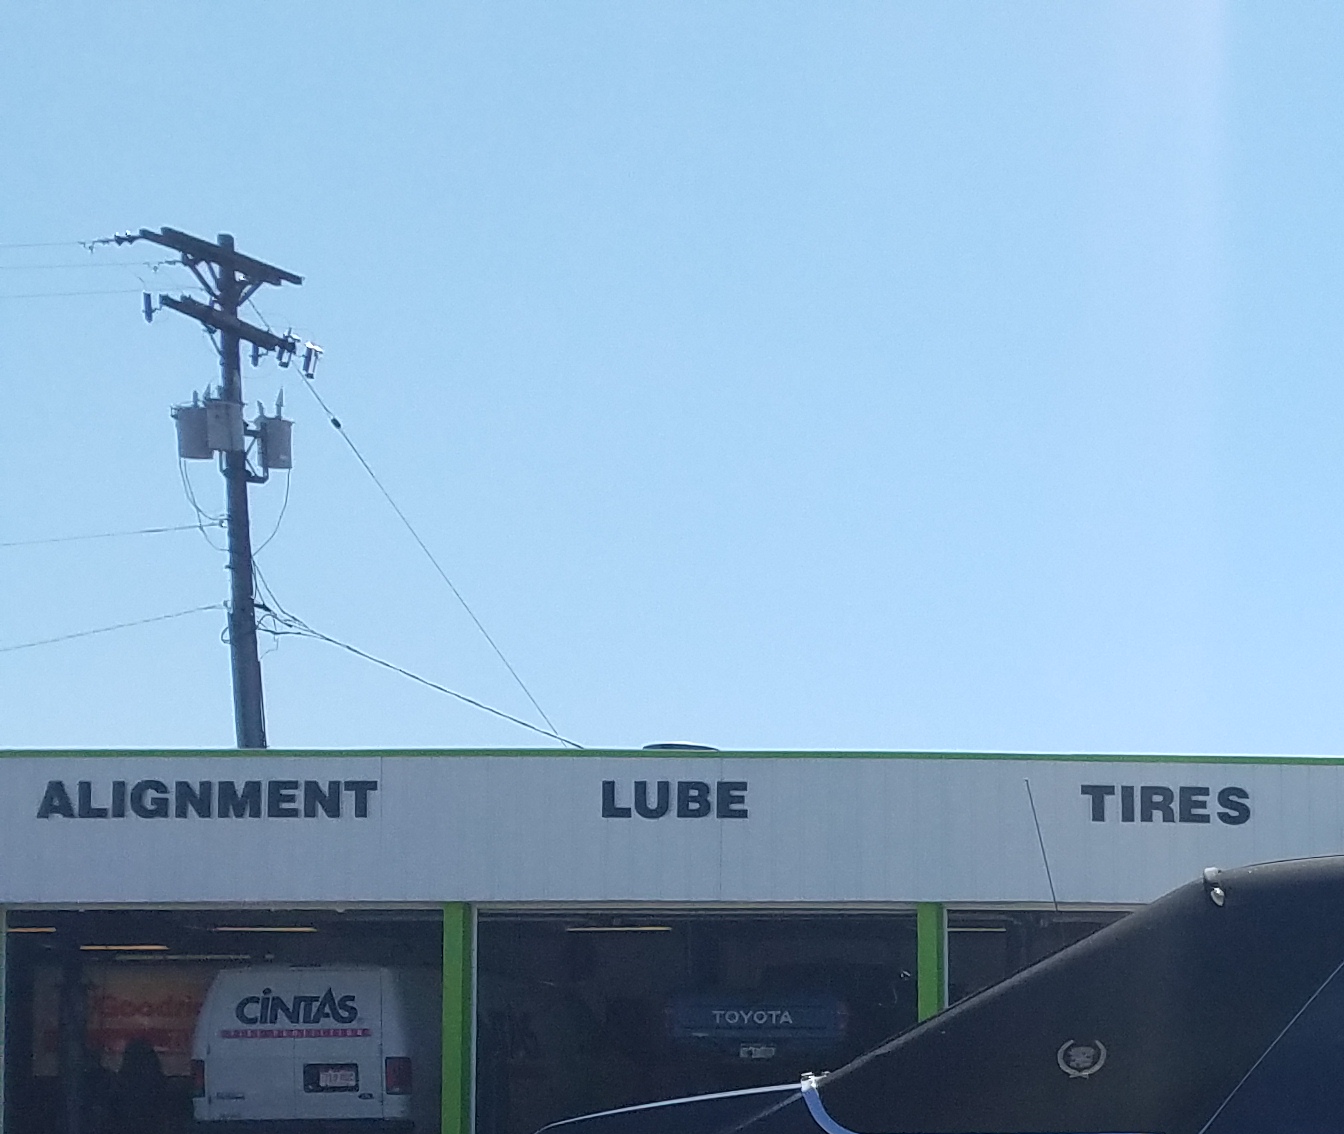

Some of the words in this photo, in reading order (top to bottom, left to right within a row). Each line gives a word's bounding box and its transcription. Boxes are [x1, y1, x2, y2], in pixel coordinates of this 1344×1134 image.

[36, 780, 379, 819] ALIGNMENT
[601, 780, 749, 819] LUBE
[1080, 784, 1251, 826] TIRES
[711, 1010, 793, 1024] TOYOTA
